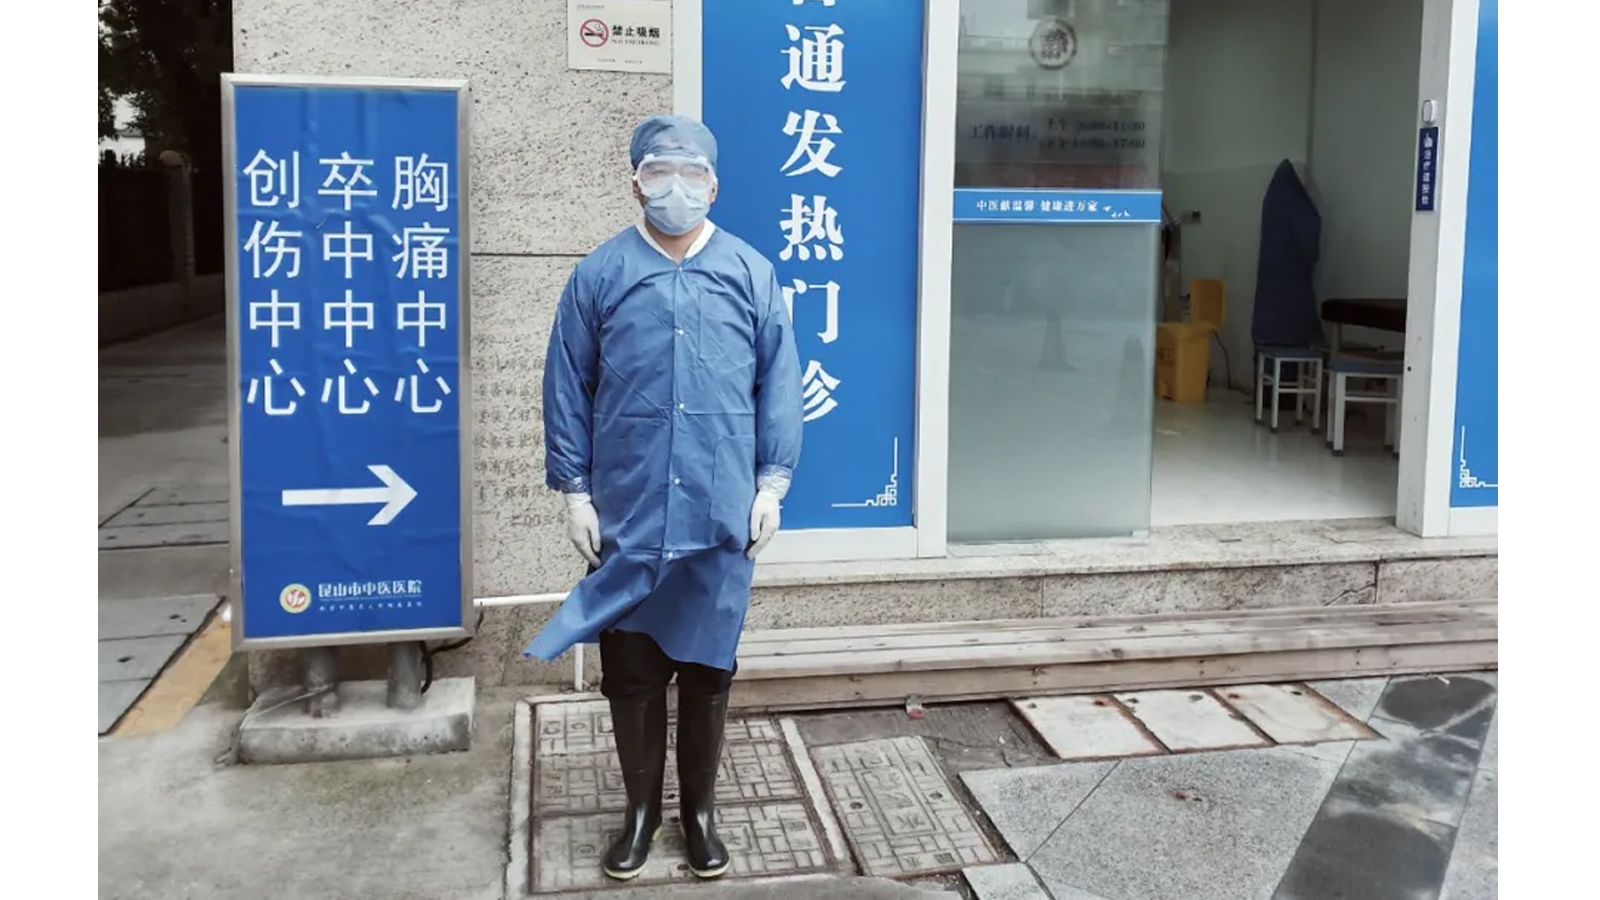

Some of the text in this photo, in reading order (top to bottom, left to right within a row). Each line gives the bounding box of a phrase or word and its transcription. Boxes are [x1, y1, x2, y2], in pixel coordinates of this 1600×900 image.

[612, 25, 660, 38] 禁止吸烟
[243, 149, 306, 416] 创伤中心
[317, 151, 380, 415] 卒中中心
[392, 153, 451, 414] 胸痛中心
[780, 0, 846, 422] 通发热门诊
[318, 579, 422, 598] 昆山市中医医院
